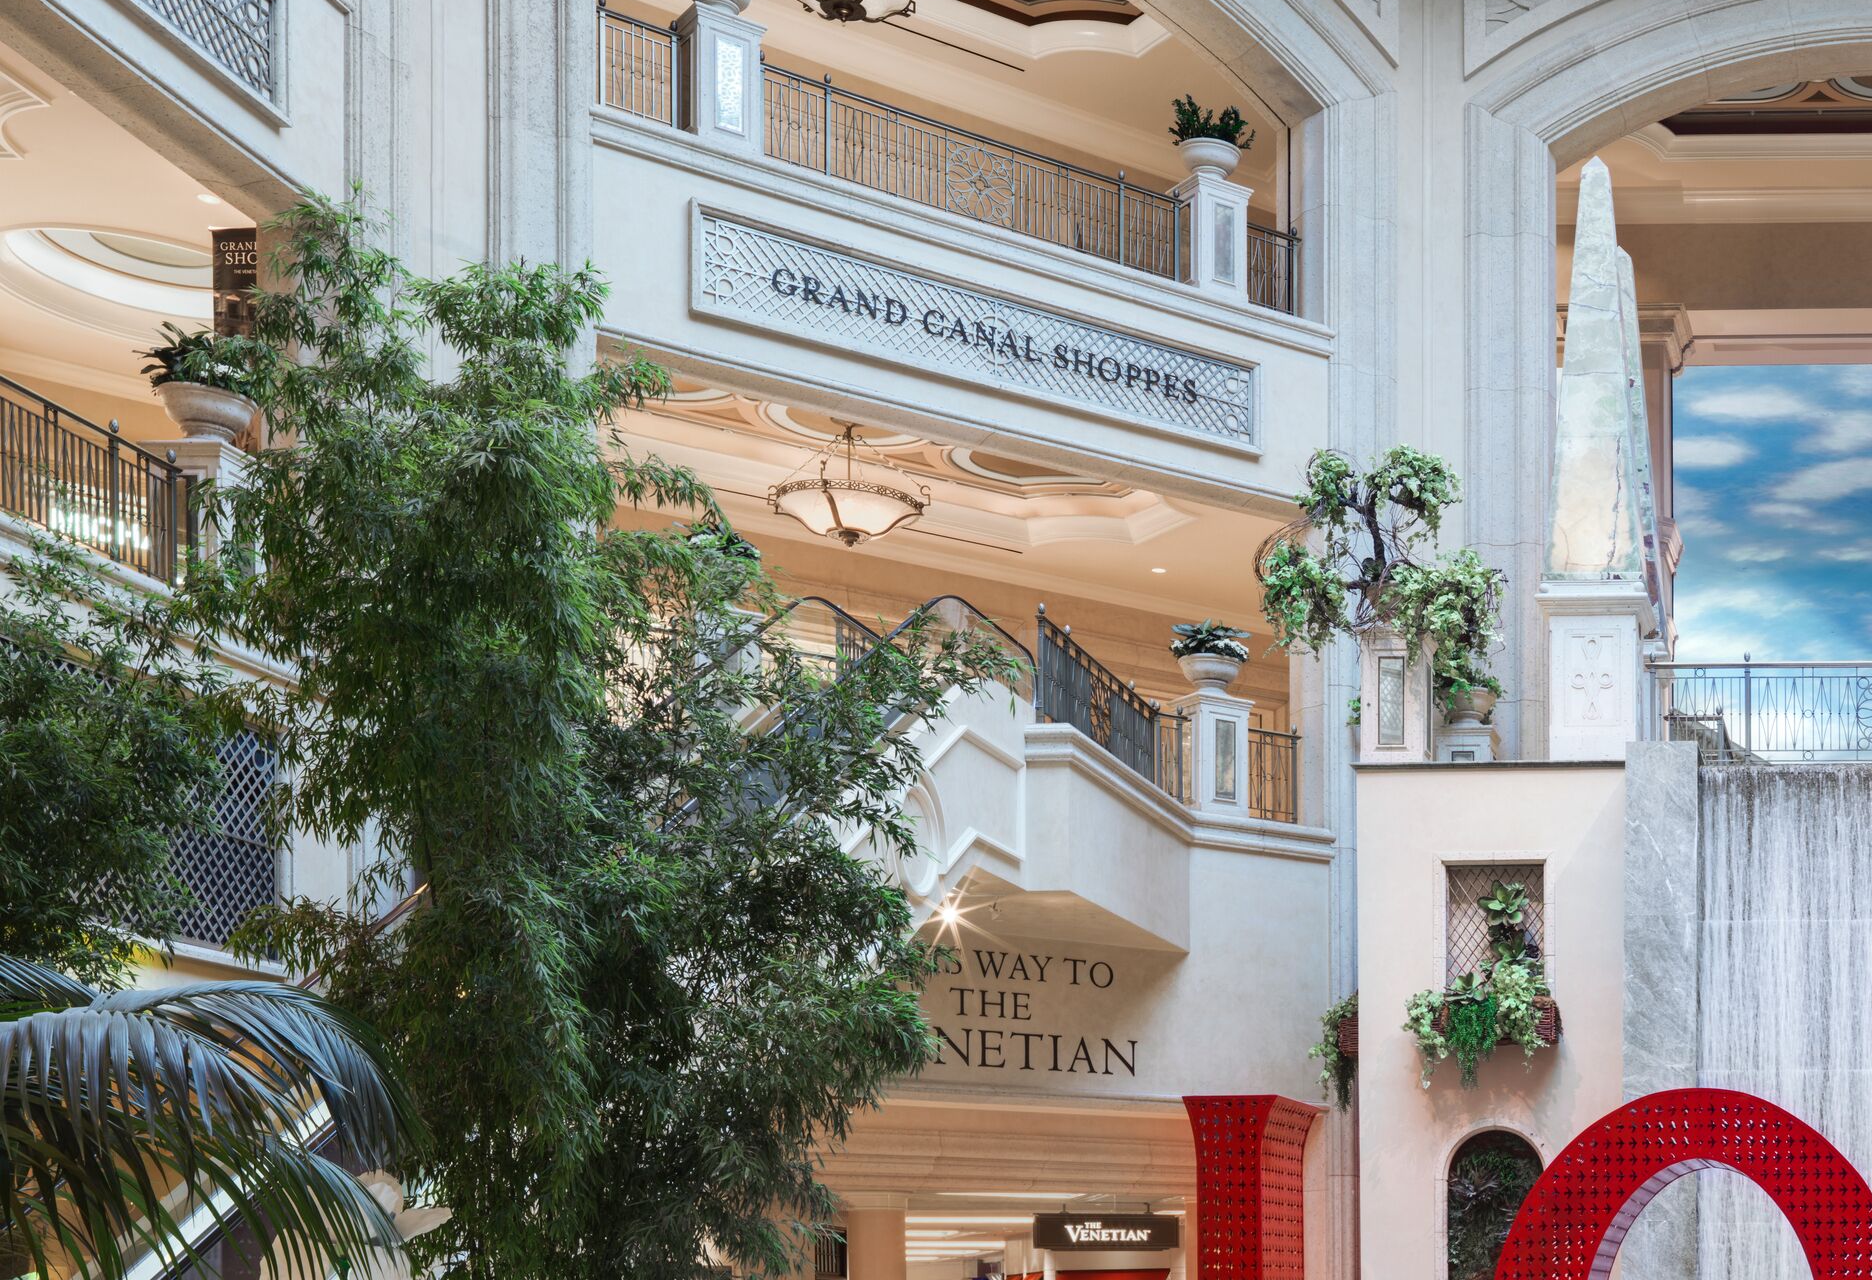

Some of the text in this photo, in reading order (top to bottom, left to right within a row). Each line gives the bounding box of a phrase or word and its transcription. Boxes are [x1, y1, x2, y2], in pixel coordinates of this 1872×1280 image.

[771, 267, 1198, 404] GRAND CANAL SHOPPES
[973, 949, 1053, 983] WAY
[1063, 957, 1114, 989] TO
[949, 987, 1032, 1021] THE
[932, 1025, 1138, 1078] NETIAN
[1064, 1225, 1149, 1242] VENETIAN
